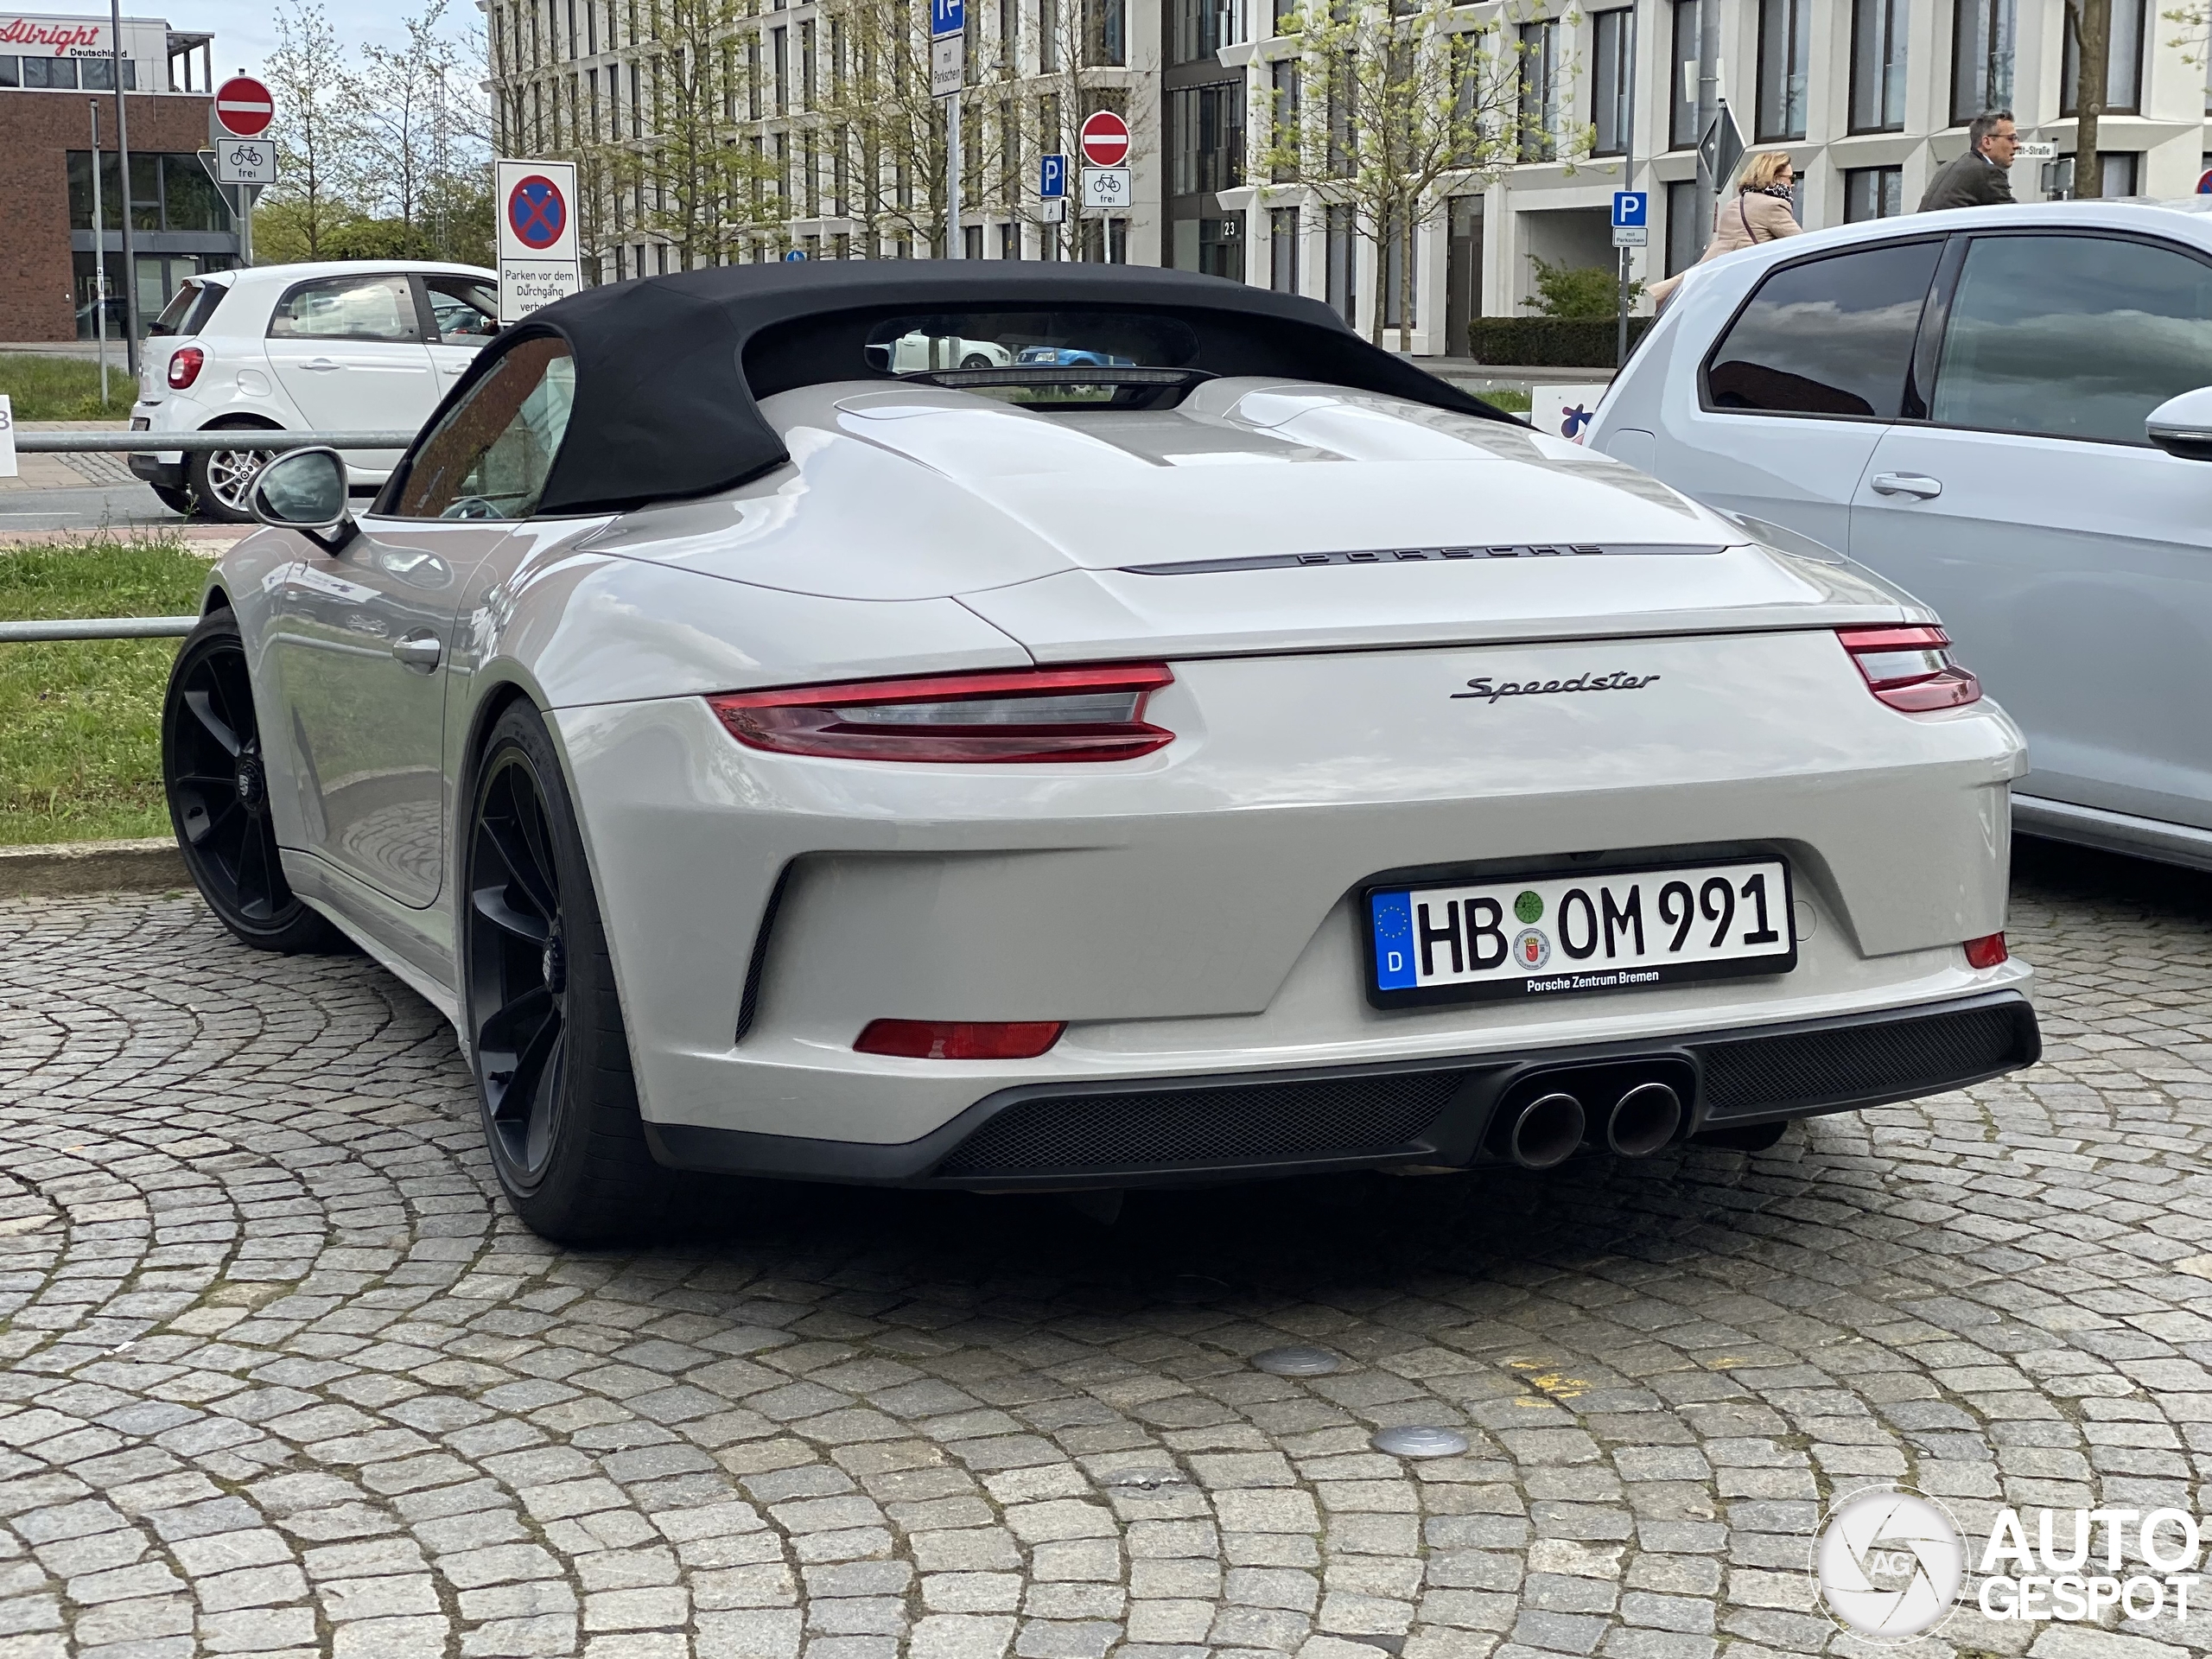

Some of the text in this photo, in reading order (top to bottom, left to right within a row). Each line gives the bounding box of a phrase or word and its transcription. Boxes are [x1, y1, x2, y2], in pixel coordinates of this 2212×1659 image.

[0, 17, 99, 56] Albright
[70, 48, 127, 58] Deutschlad
[934, 66, 960, 85] Parkschein
[238, 168, 257, 178] frei
[1046, 161, 1058, 191] P
[1100, 194, 1116, 203] frei
[1621, 196, 1639, 222] P
[1224, 221, 1235, 236] 23
[505, 270, 536, 281] Parken
[554, 270, 574, 281] dem
[517, 285, 564, 299] Durchgang
[1296, 543, 1603, 563] PORSCHE
[1450, 671, 1661, 704] Speedster
[1388, 951, 1402, 972] D
[1417, 897, 1509, 976] HB
[1557, 884, 1645, 960] OM
[1658, 873, 1780, 953] 991
[1527, 970, 1660, 993] Porsche Zentrum Bremen
